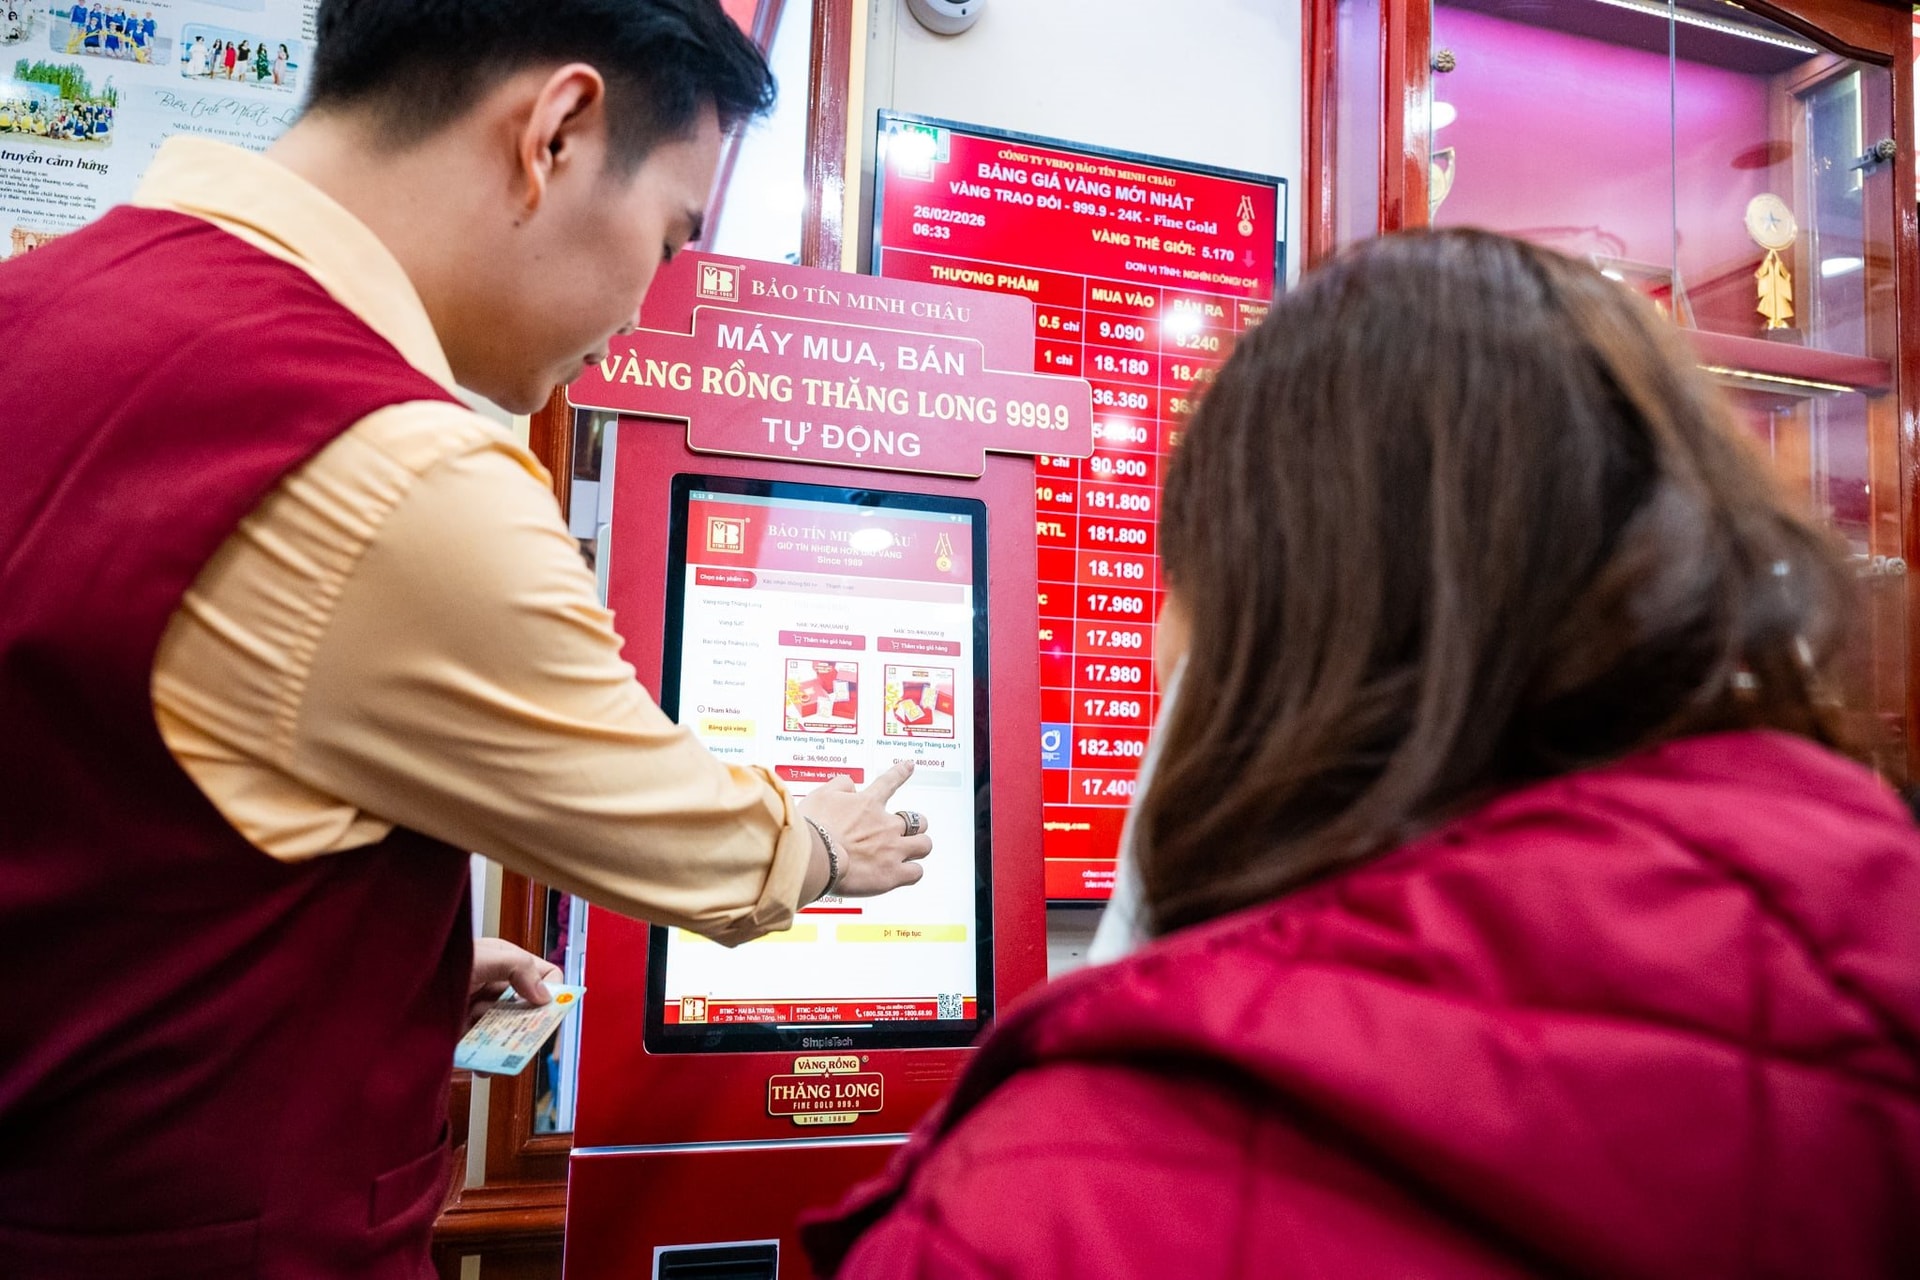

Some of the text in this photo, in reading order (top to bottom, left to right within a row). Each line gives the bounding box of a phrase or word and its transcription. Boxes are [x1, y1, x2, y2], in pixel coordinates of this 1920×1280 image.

[1, 149, 109, 175] truyền cảm hứng
[998, 150, 1029, 163] CÔNG
[1030, 154, 1043, 166] TY
[1117, 169, 1146, 183] MINH
[1031, 171, 1061, 190] GIÁ
[1064, 176, 1111, 197] VÀNG
[1115, 183, 1147, 204] MỚI
[913, 204, 986, 227] 26/02/2026
[949, 180, 992, 199] VÀNG
[994, 188, 1034, 206] TRAO
[1073, 200, 1107, 217] 999.9
[1117, 207, 1142, 223] 24K
[1153, 214, 1183, 229] Fine
[1185, 218, 1217, 235] Gold
[912, 222, 950, 239] 06:33
[1092, 229, 1131, 246] VÀNG
[1201, 246, 1235, 262] 5.170
[930, 265, 995, 286] THƯƠNG
[752, 277, 971, 323] BẢO TÍN MINH CHÂU
[1092, 288, 1154, 308] MUA VÀO
[1173, 299, 1224, 317] BÁN RA
[1038, 314, 1061, 329] 0.5
[1099, 321, 1145, 342] 9.090
[717, 323, 965, 376] MÁY MUA, BÁN
[1043, 350, 1052, 364] 1
[1094, 354, 1149, 376] 18.180
[600, 349, 1070, 431] VÀNG RỒNG THĂNG LONG 999.9
[1093, 388, 1148, 409] 36.360
[761, 417, 921, 459] TỰ ĐỘNG
[1090, 456, 1147, 477] 90.900
[1035, 486, 1053, 501] 10
[1085, 490, 1151, 511] 181.800
[767, 522, 799, 538] BẢO
[801, 526, 826, 540] TÍN
[1087, 525, 1147, 544] 181.800
[817, 555, 863, 567] Since 1989
[1088, 560, 1145, 580] 18.180
[1087, 594, 1144, 614] 17.960
[1086, 629, 1143, 649] 17.980
[1085, 664, 1142, 683] 17.980
[1084, 699, 1141, 718] 17.860
[1078, 738, 1144, 757] 182.300
[1082, 779, 1137, 796] 17.400
[798, 1057, 857, 1070] VÀNG RỒNG
[772, 1082, 880, 1100] THĂNG LONG
[793, 1100, 860, 1110] FINE GOLD 999.9
